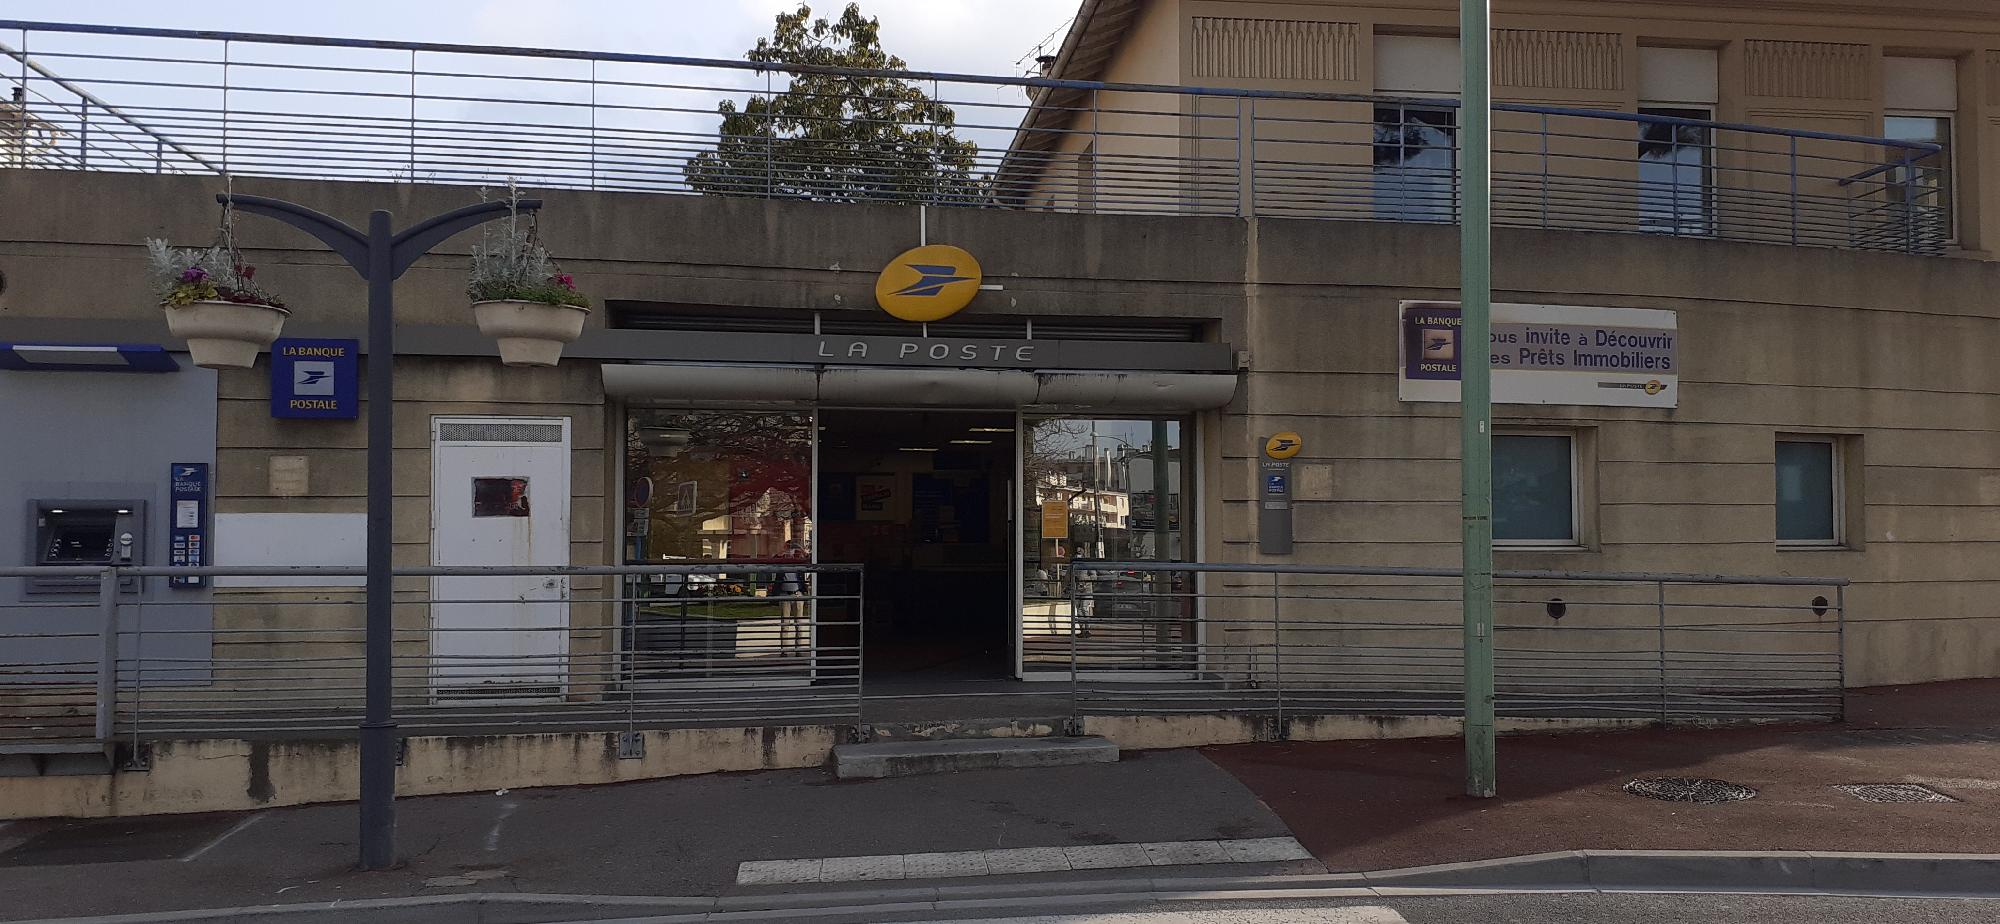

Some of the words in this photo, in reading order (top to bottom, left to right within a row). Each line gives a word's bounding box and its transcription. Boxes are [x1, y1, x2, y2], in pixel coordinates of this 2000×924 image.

[1414, 317, 1426, 326] LA
[1427, 317, 1462, 328] BANQUE
[1490, 332, 1517, 344] ous
[1525, 326, 1571, 346] invite
[1579, 333, 1588, 346] à
[1595, 329, 1673, 349] Découvrir
[283, 346, 297, 356] LA
[298, 347, 345, 358] BANQUE
[818, 341, 868, 358] LA
[899, 343, 1035, 361] POSTE
[1490, 354, 1511, 365] es
[1519, 348, 1565, 366] Prêts
[1573, 349, 1671, 370] Immobiliers
[1420, 363, 1458, 373] POSTALE
[290, 399, 337, 410] POSTALE
